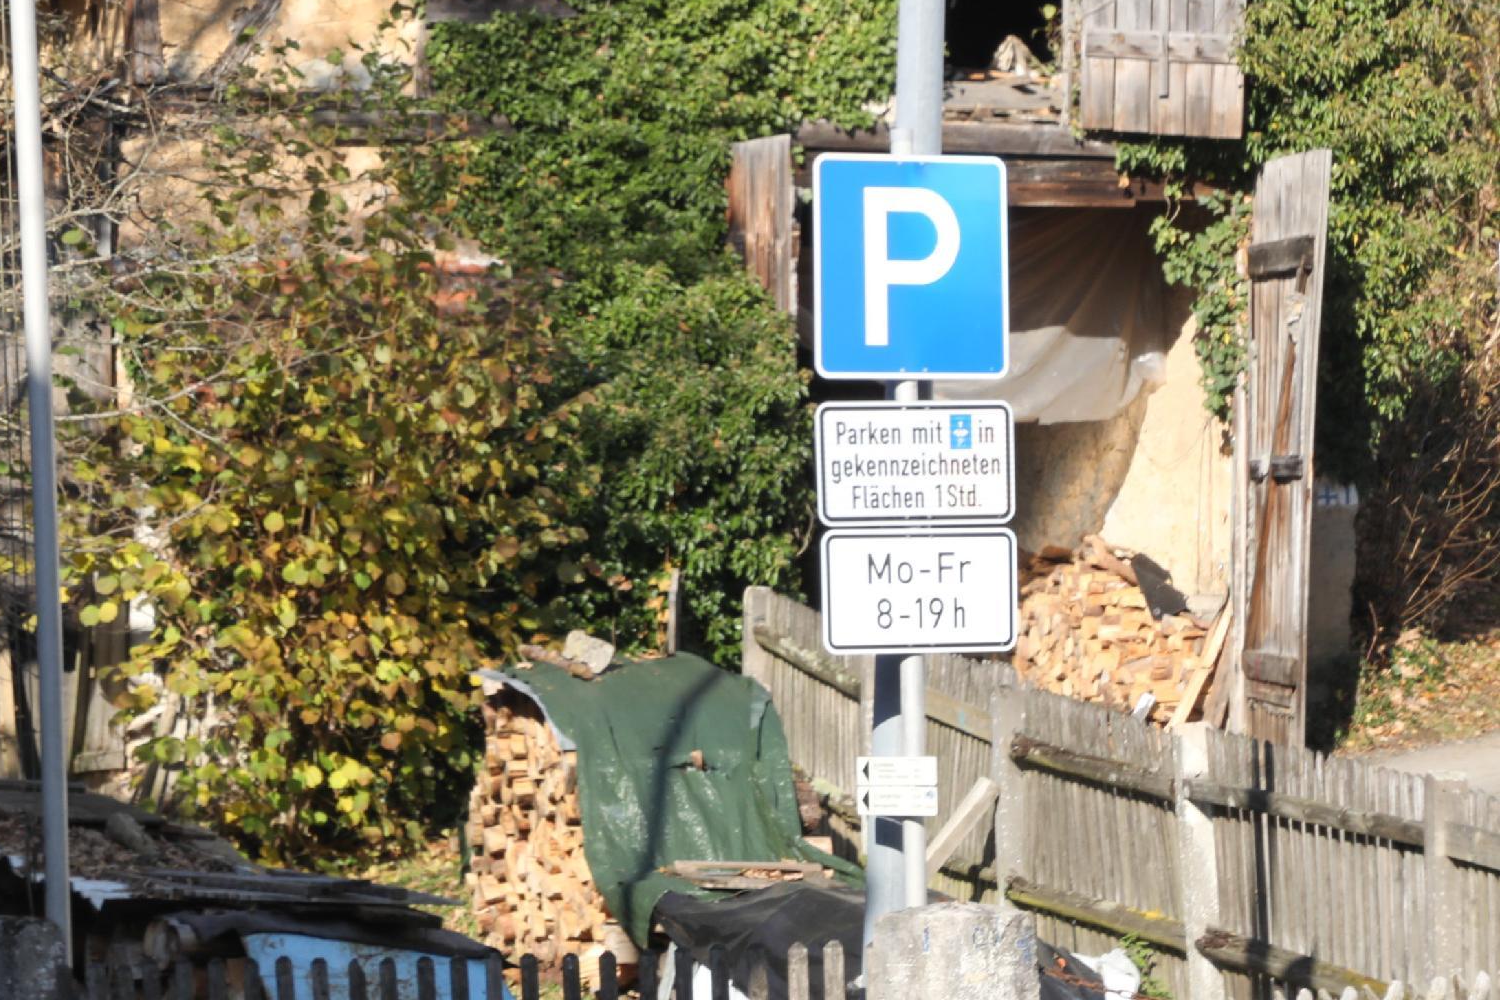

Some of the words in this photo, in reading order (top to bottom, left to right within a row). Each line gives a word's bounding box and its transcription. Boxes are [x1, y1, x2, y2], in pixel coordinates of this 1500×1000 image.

[863, 186, 961, 346] P
[835, 421, 901, 445] Parken
[912, 421, 943, 444] mit
[978, 421, 994, 442] in
[831, 453, 1001, 484] gekennzeichneten
[851, 486, 925, 509] Flächen
